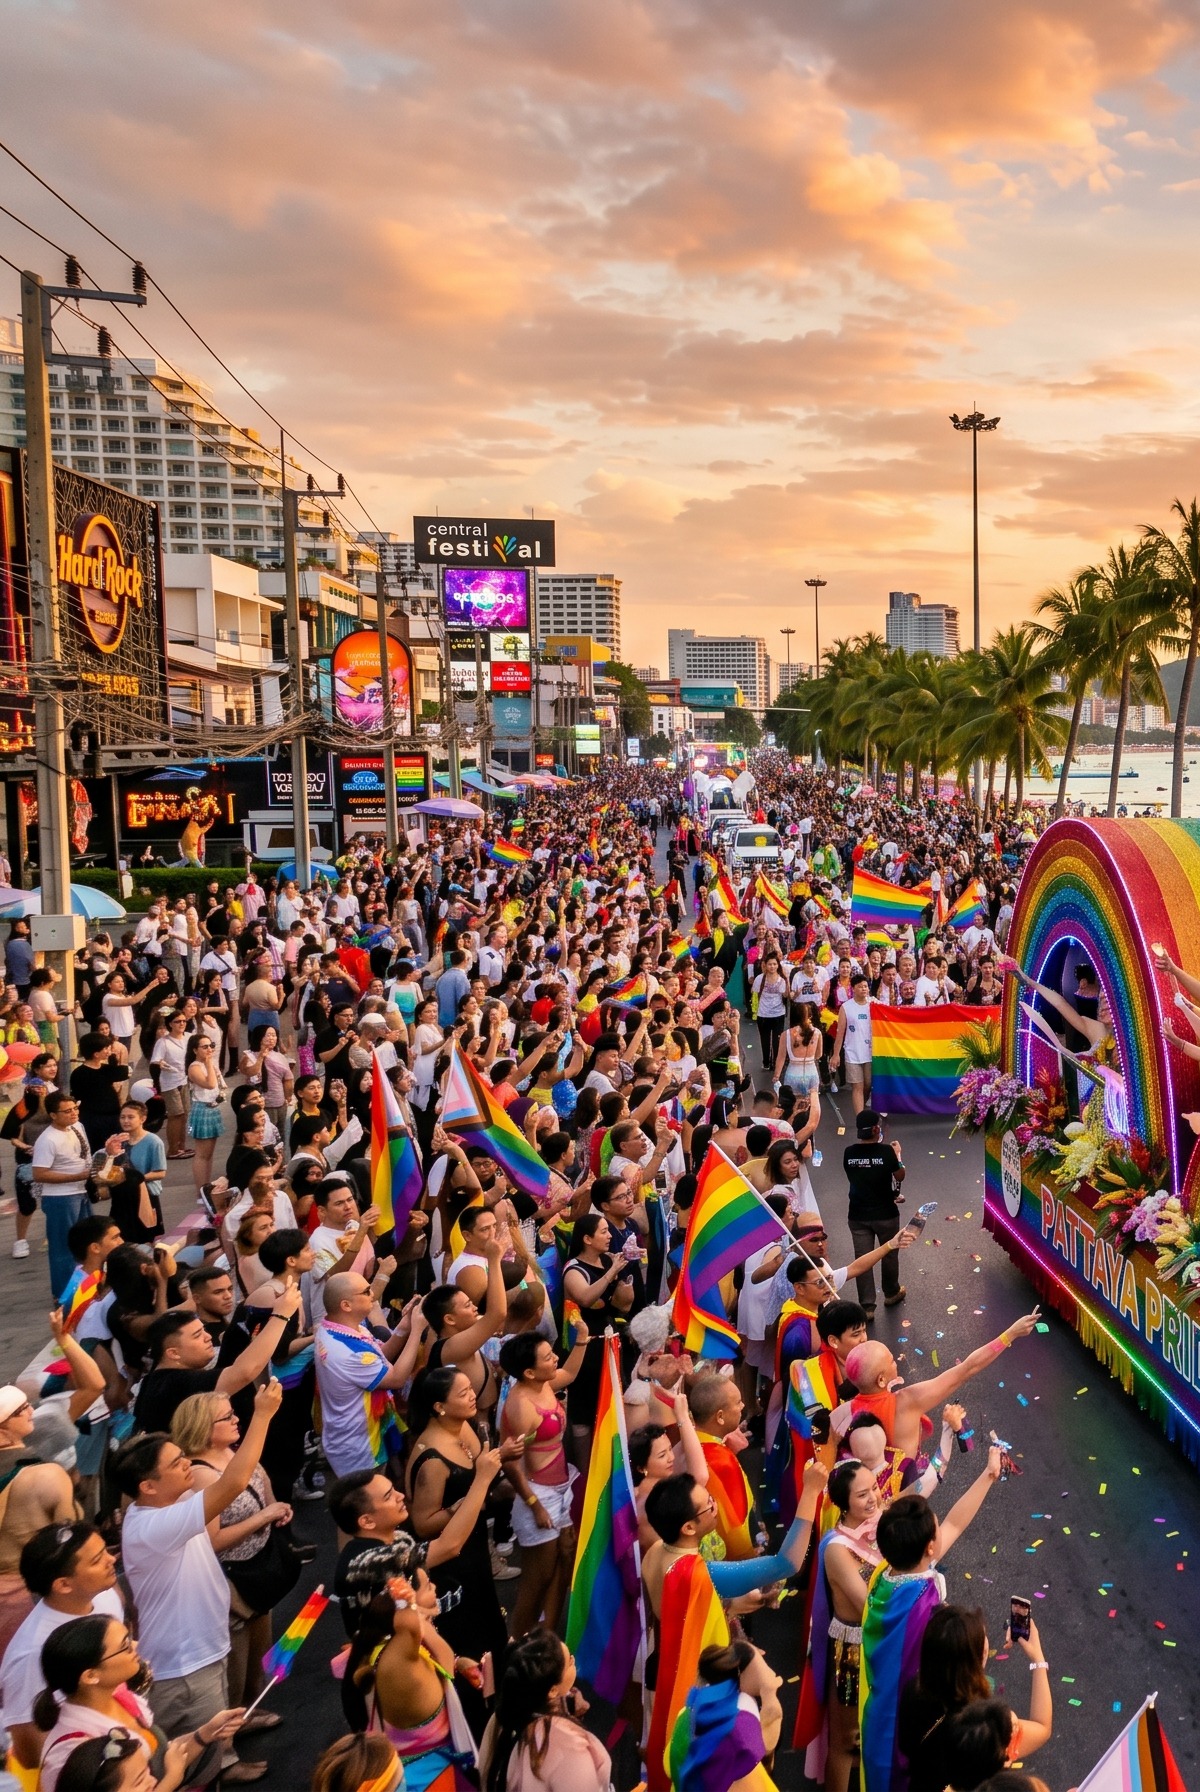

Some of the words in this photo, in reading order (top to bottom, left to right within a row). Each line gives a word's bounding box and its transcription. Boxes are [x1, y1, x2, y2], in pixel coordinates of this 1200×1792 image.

[427, 522, 488, 537] central
[58, 534, 104, 589] Hard
[105, 547, 143, 608] Rock
[1039, 1183, 1140, 1332] PATTAYA
